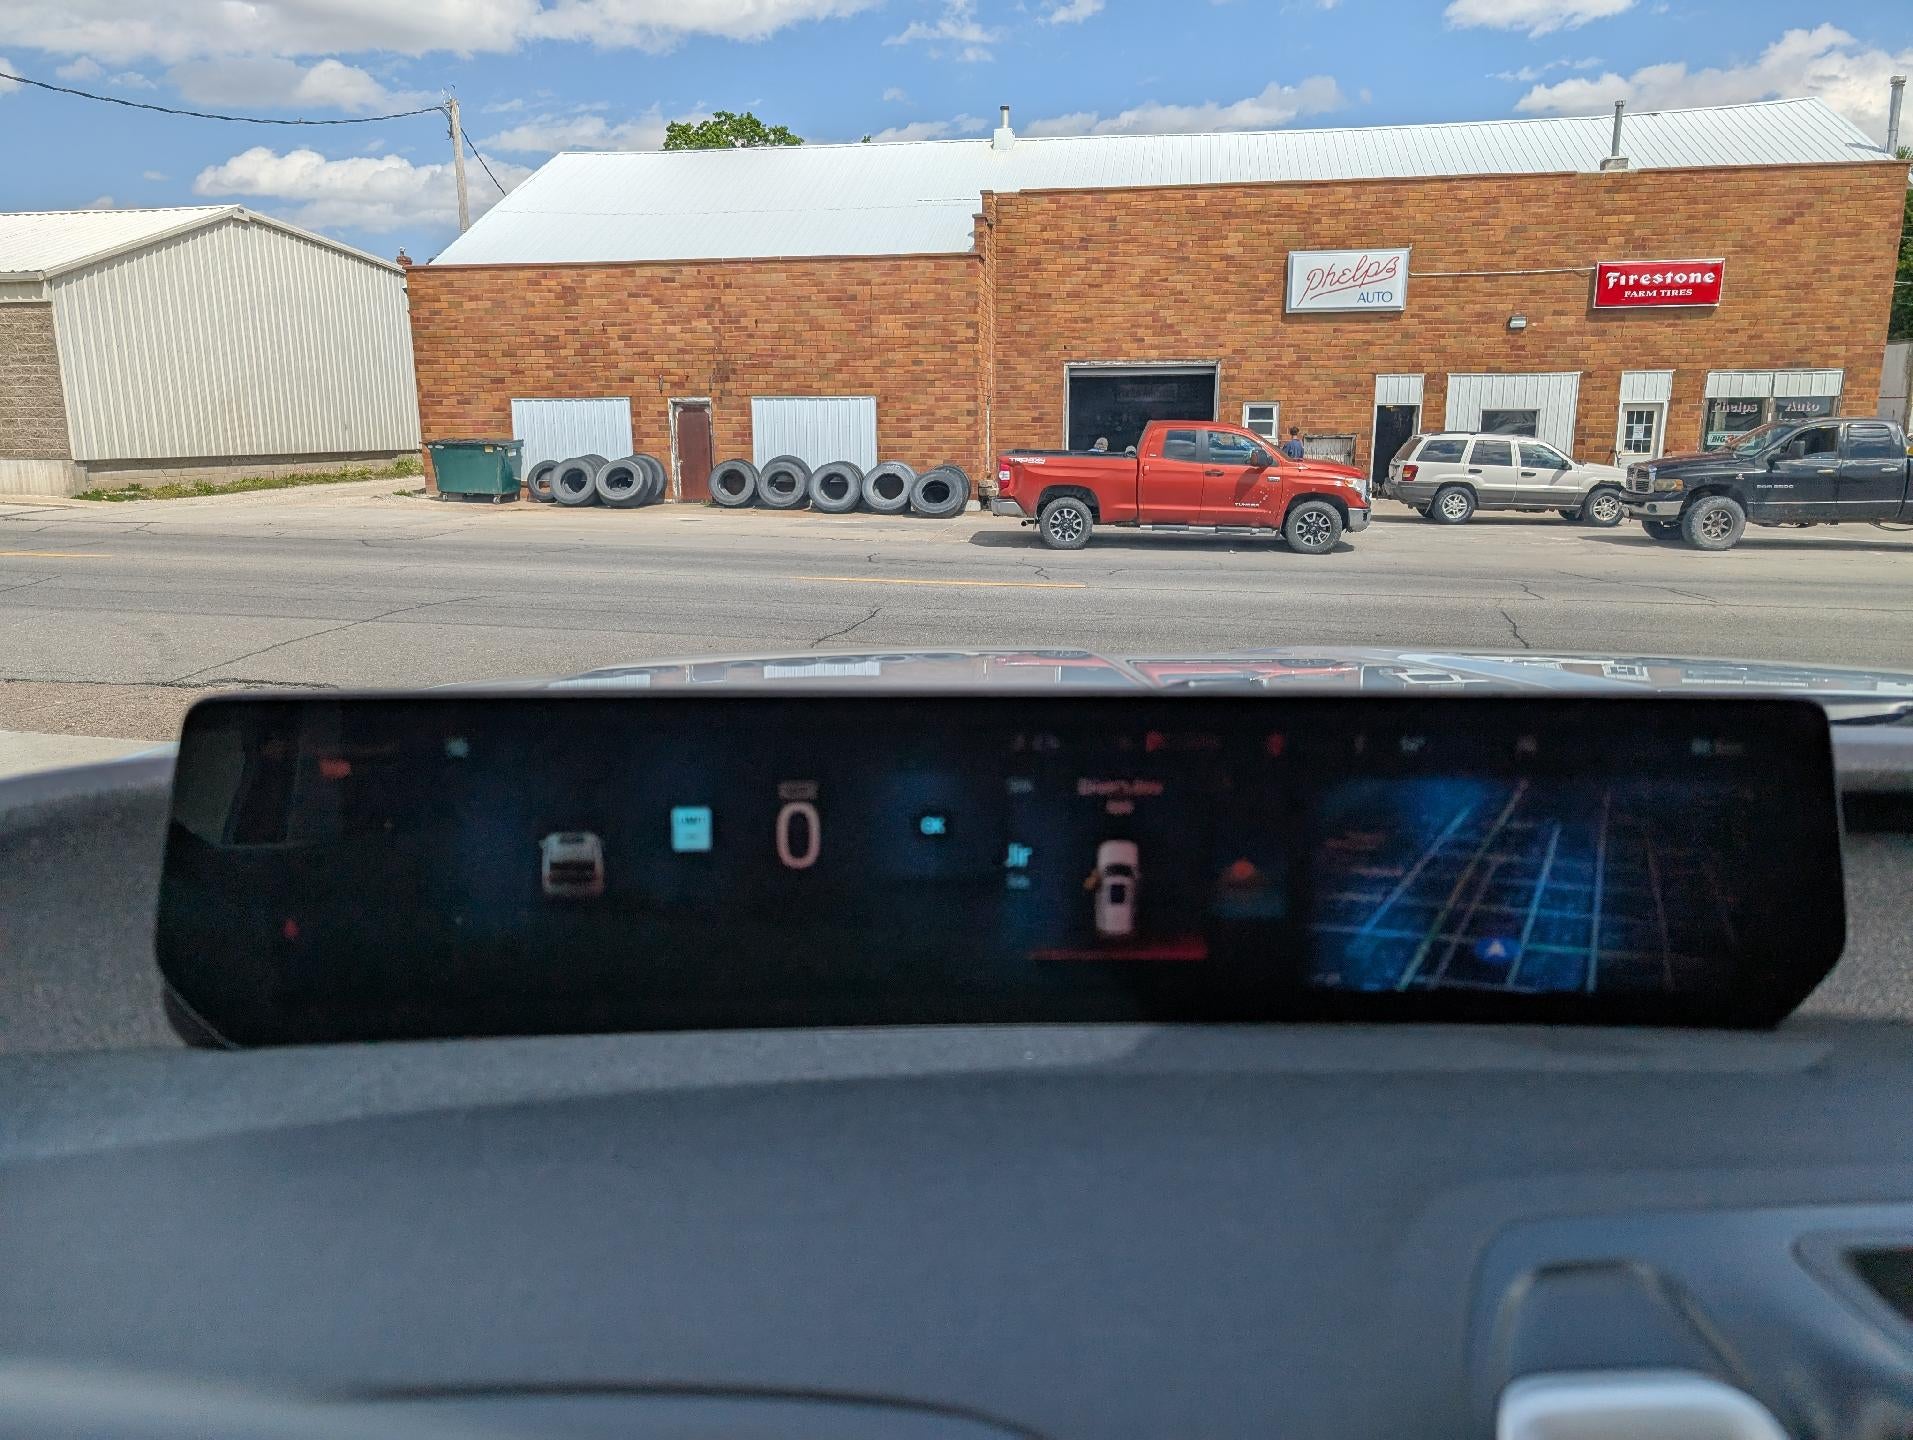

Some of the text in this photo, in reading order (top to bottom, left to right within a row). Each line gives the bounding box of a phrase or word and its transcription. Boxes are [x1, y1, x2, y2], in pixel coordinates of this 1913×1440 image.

[1605, 271, 1716, 290] Firestone
[1356, 290, 1393, 304] AUTO
[1624, 288, 1693, 298] FARM TIRES
[1711, 400, 1820, 415] Phelps Auto
[774, 801, 817, 868] 0
